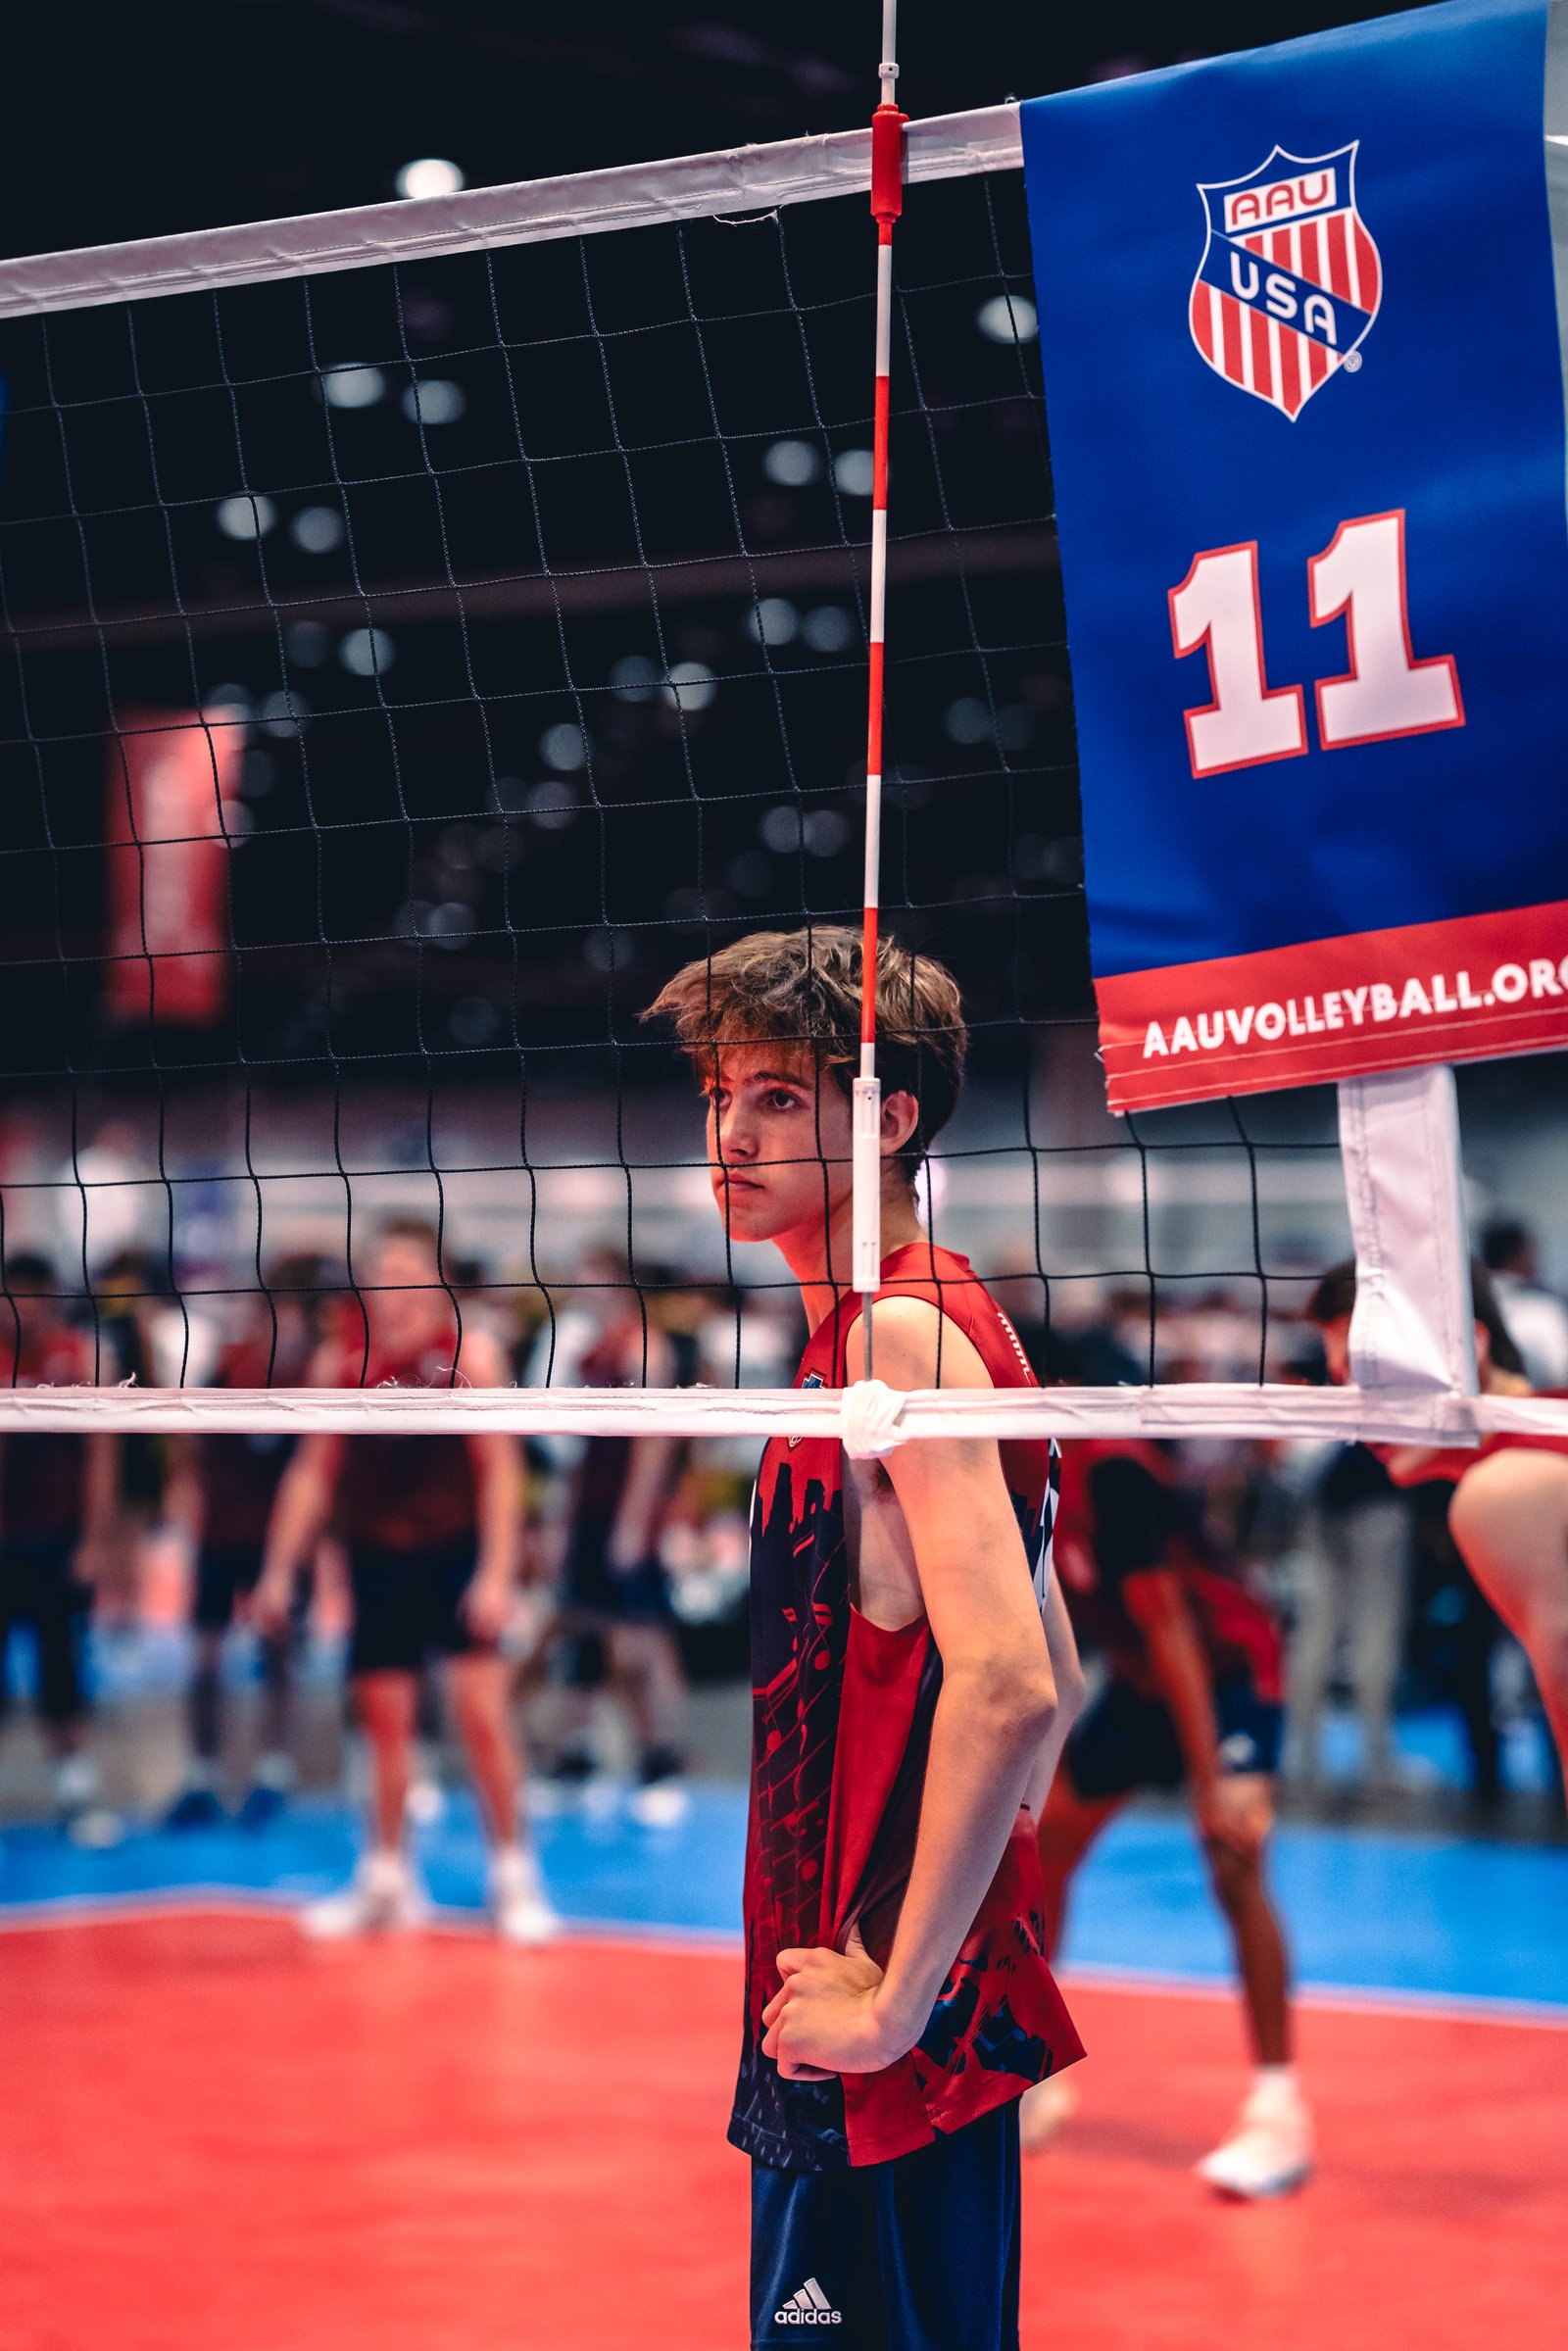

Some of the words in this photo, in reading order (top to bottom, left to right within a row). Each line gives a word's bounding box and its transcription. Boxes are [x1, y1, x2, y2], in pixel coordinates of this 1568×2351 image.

[1231, 172, 1329, 226] AAU
[1230, 251, 1338, 346] USA
[1167, 508, 1466, 779] 11
[1142, 955, 1568, 1059] AAUVOLLEYBALL.OR
[774, 2308, 843, 2325] adidas
